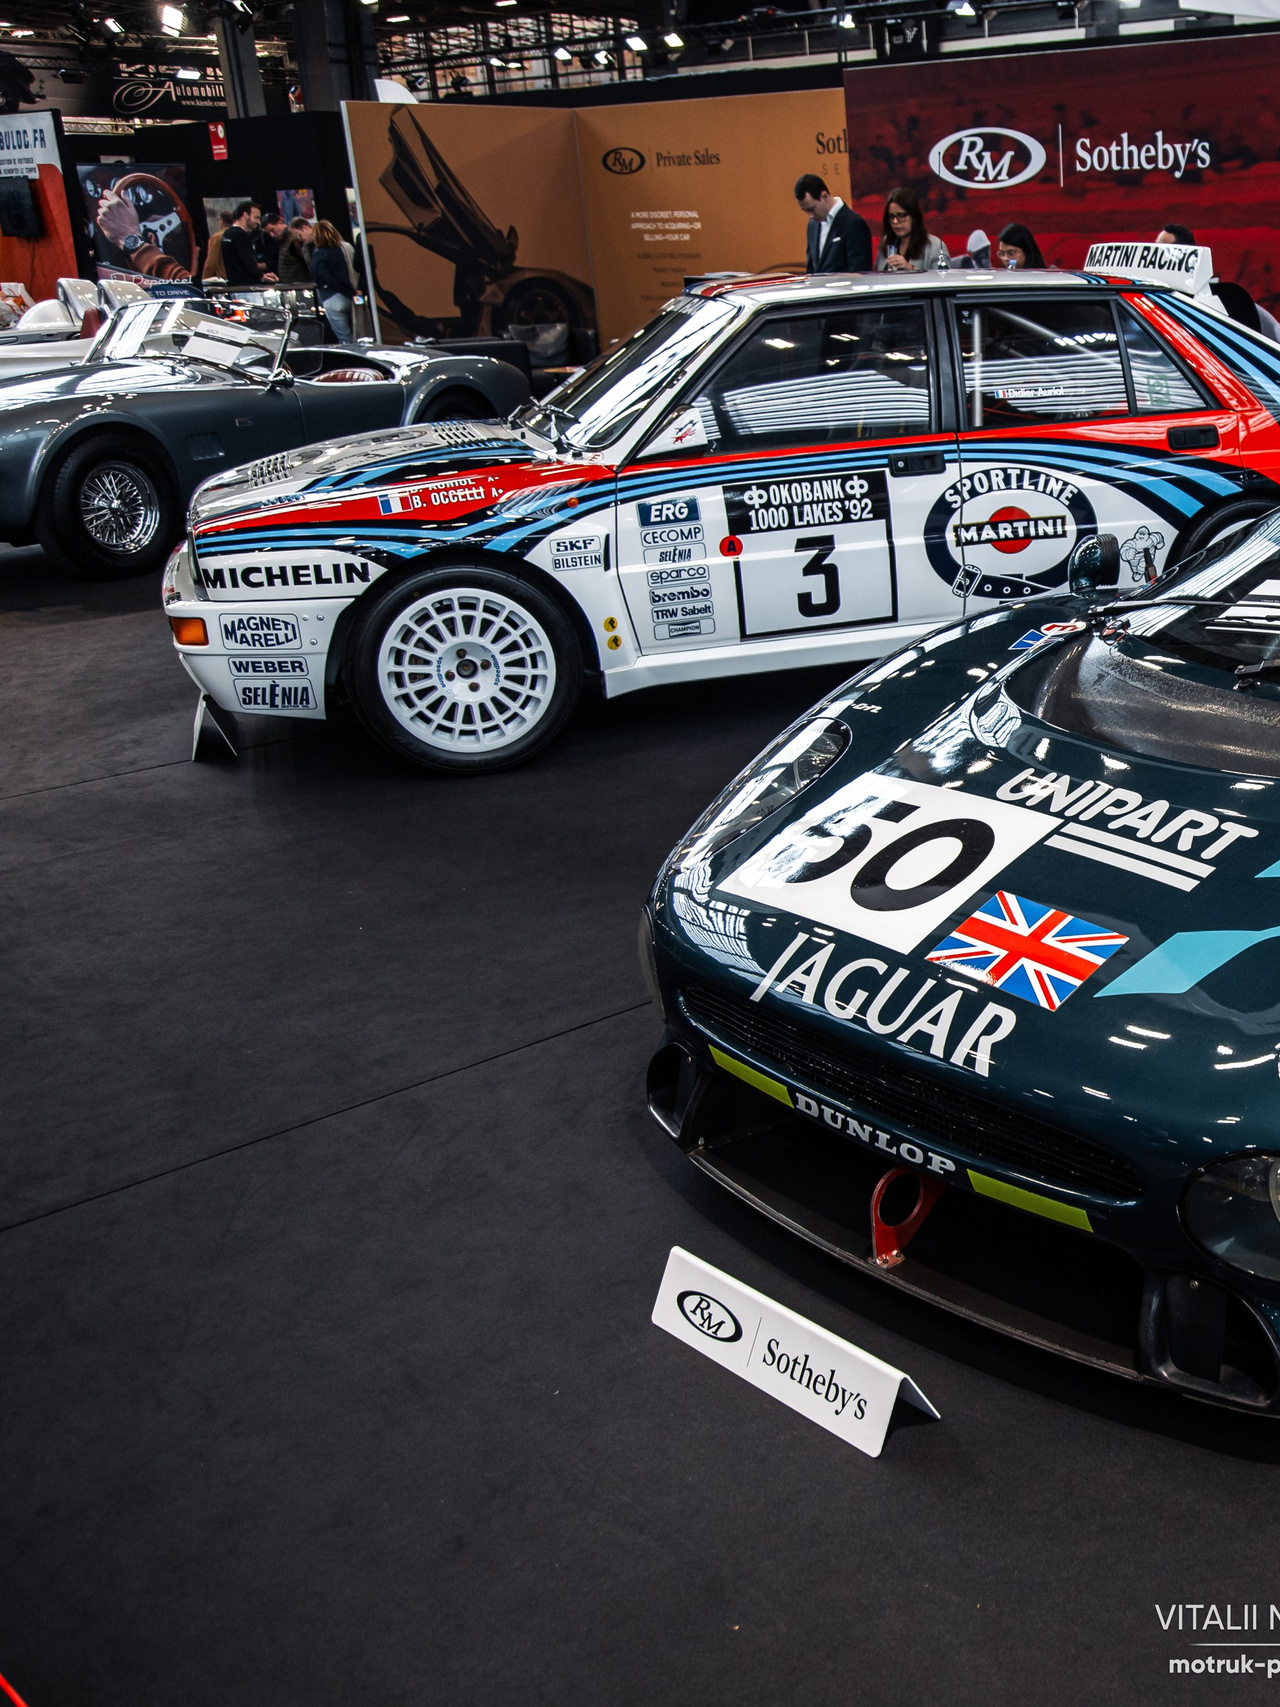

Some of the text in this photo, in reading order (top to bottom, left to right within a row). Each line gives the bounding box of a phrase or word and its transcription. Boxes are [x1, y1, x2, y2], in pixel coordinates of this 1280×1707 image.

[656, 148, 721, 168] Private Sales
[1075, 130, 1212, 180] Sotheby's
[1086, 245, 1138, 268] MARTINI
[412, 495, 427, 508] B.
[431, 485, 485, 506] OCCELLI
[769, 479, 845, 506] OKOBANK
[944, 468, 1079, 509] SPORTLINE
[650, 502, 689, 523] ERG
[749, 498, 873, 531] 1000 LAKES '92
[643, 526, 701, 545] CECOMP
[957, 518, 1064, 543] MARTINI
[556, 538, 595, 553] SKF
[727, 540, 737, 553] A
[554, 554, 601, 572] BILSTEIN
[201, 561, 372, 590] MICHELIN
[650, 566, 706, 585] sparco
[794, 534, 841, 618] 3
[651, 586, 710, 604] brembo
[654, 604, 712, 620] TRW Sabelt
[223, 616, 297, 638] MAGNETI
[224, 629, 297, 648] MARELLI
[670, 625, 700, 634] CHAMPION
[232, 660, 305, 673] WEBER
[995, 767, 1259, 860] UNIPART
[780, 796, 996, 912] 50
[750, 932, 1017, 1078] JAGUAR
[795, 1092, 957, 1175] DUNLOP
[761, 1337, 869, 1420] Sotheby's
